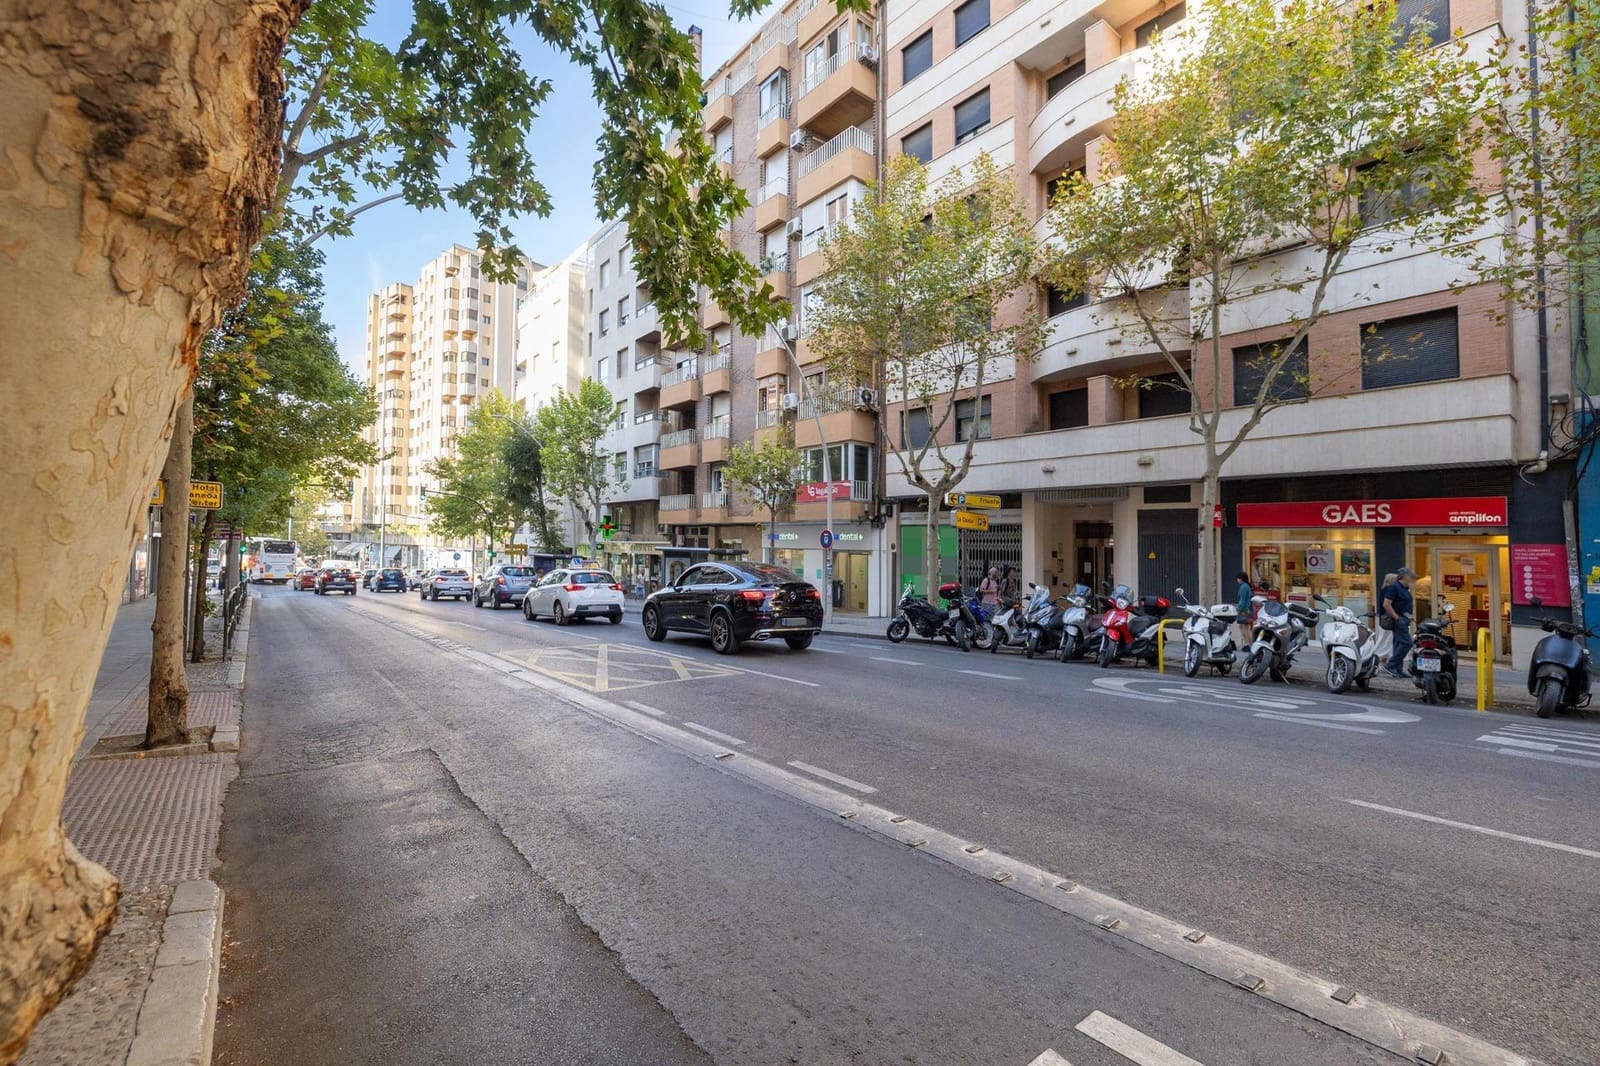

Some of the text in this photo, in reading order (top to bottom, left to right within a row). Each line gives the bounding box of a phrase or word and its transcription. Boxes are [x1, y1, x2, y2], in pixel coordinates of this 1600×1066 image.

[192, 483, 218, 492] Hotel
[1322, 503, 1393, 524] GAES
[1449, 513, 1502, 524] amplifon
